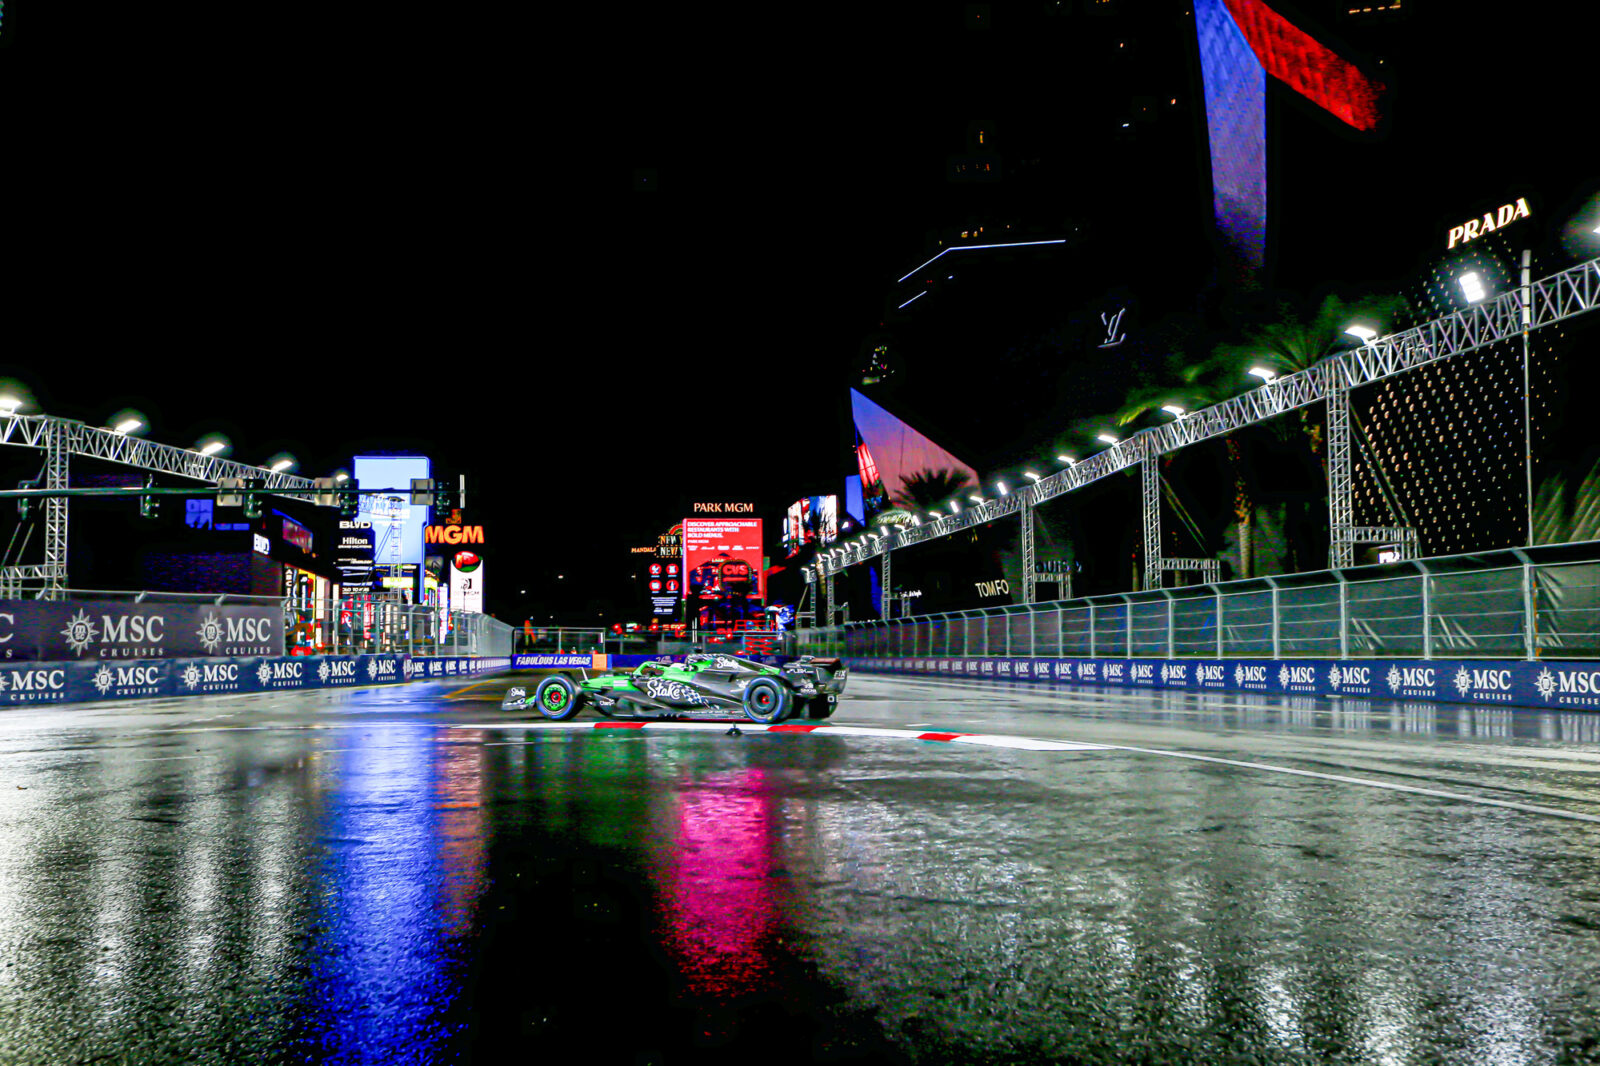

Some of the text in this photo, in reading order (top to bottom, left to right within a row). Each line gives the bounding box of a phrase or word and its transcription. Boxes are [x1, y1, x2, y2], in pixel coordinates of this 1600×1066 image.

[1447, 197, 1530, 249] PRADA
[694, 503, 754, 512] PARK MGM
[339, 520, 372, 529] BLVD
[425, 524, 484, 545] MGM
[660, 535, 677, 544] NEW
[660, 546, 678, 556] NEW
[722, 564, 748, 575] CVS
[101, 615, 164, 643] MSC
[226, 618, 271, 642] MSC
[100, 648, 164, 657] CRUISES
[226, 647, 271, 655] CRUISES
[378, 659, 396, 674] MSC
[516, 656, 591, 665] FABULOUS LAS VEGAS
[204, 664, 238, 682] MSC
[273, 662, 303, 679] MSC
[331, 661, 356, 676] MSC
[1039, 663, 1049, 673] MSC
[1060, 663, 1072, 674] MSC
[1083, 663, 1096, 675] MSC
[1109, 664, 1123, 676] MSC
[1137, 665, 1153, 678] MSC
[1169, 665, 1186, 679] MSC
[1205, 666, 1224, 680] MSC
[1245, 666, 1266, 681] MSC
[1291, 667, 1315, 683] MSC
[11, 670, 64, 690] MSC
[117, 667, 159, 686] MSC
[1342, 667, 1370, 684] MSC
[1402, 668, 1435, 687] MSC
[1473, 670, 1512, 690] MSC
[1558, 671, 1600, 694] MSC
[10, 692, 64, 700] CRUISES
[647, 679, 680, 700] Stake
[1473, 692, 1512, 700] CRUISES
